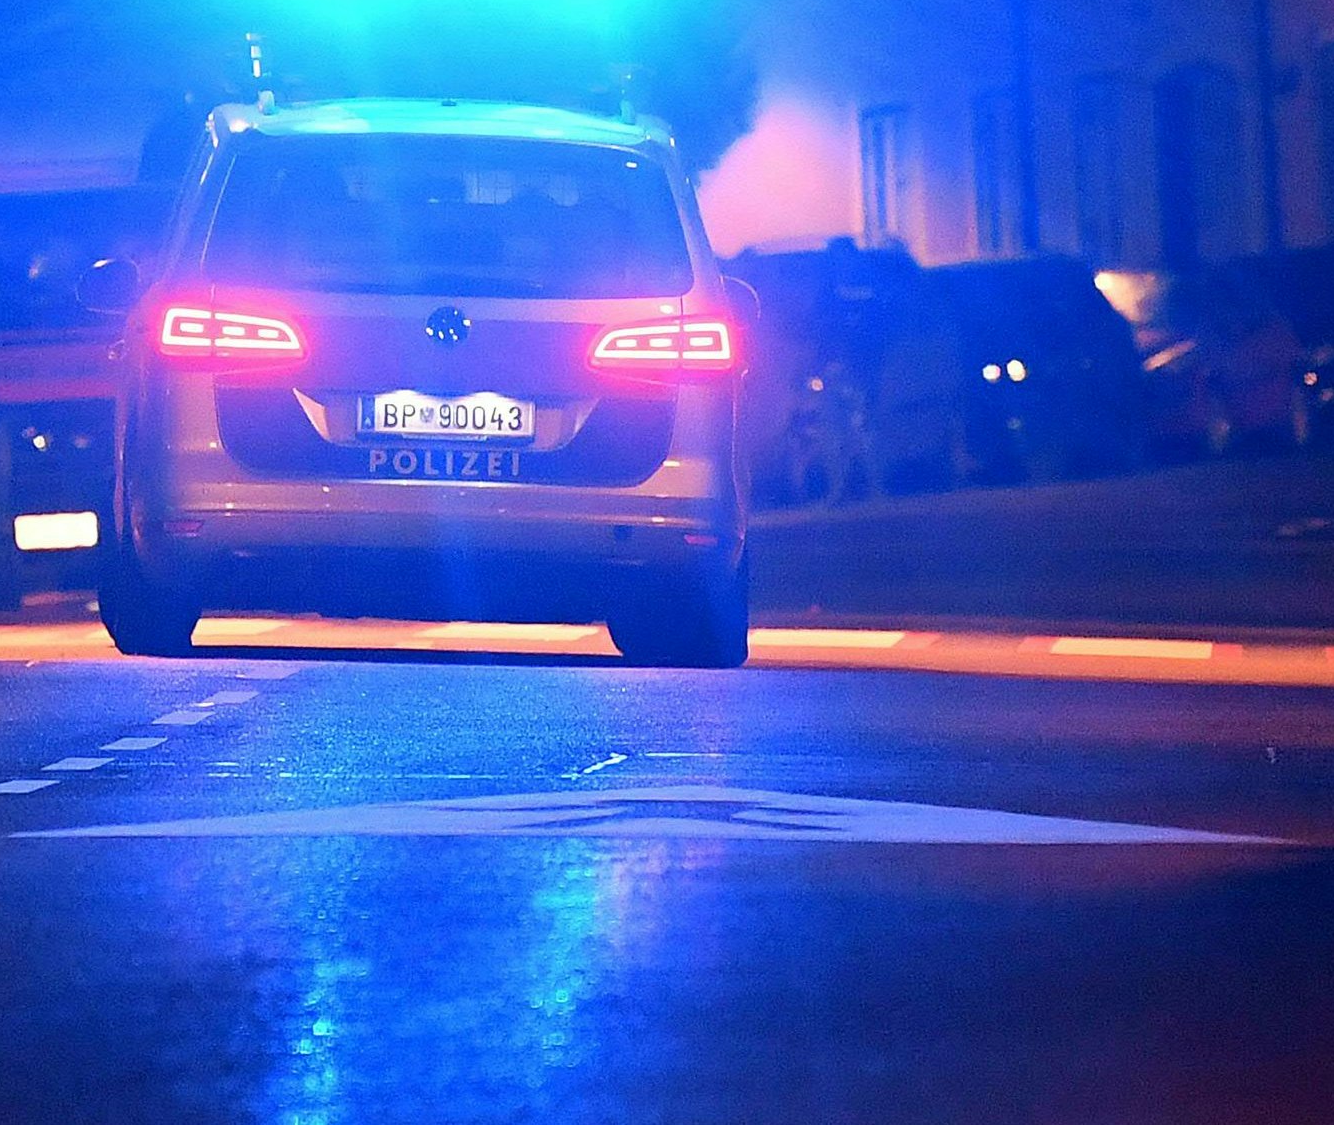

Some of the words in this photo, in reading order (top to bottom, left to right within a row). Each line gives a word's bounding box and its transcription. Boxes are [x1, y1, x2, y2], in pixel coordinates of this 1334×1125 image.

[383, 403, 416, 428] BP
[439, 403, 523, 431] 90043
[370, 450, 521, 476] POLIZEI
